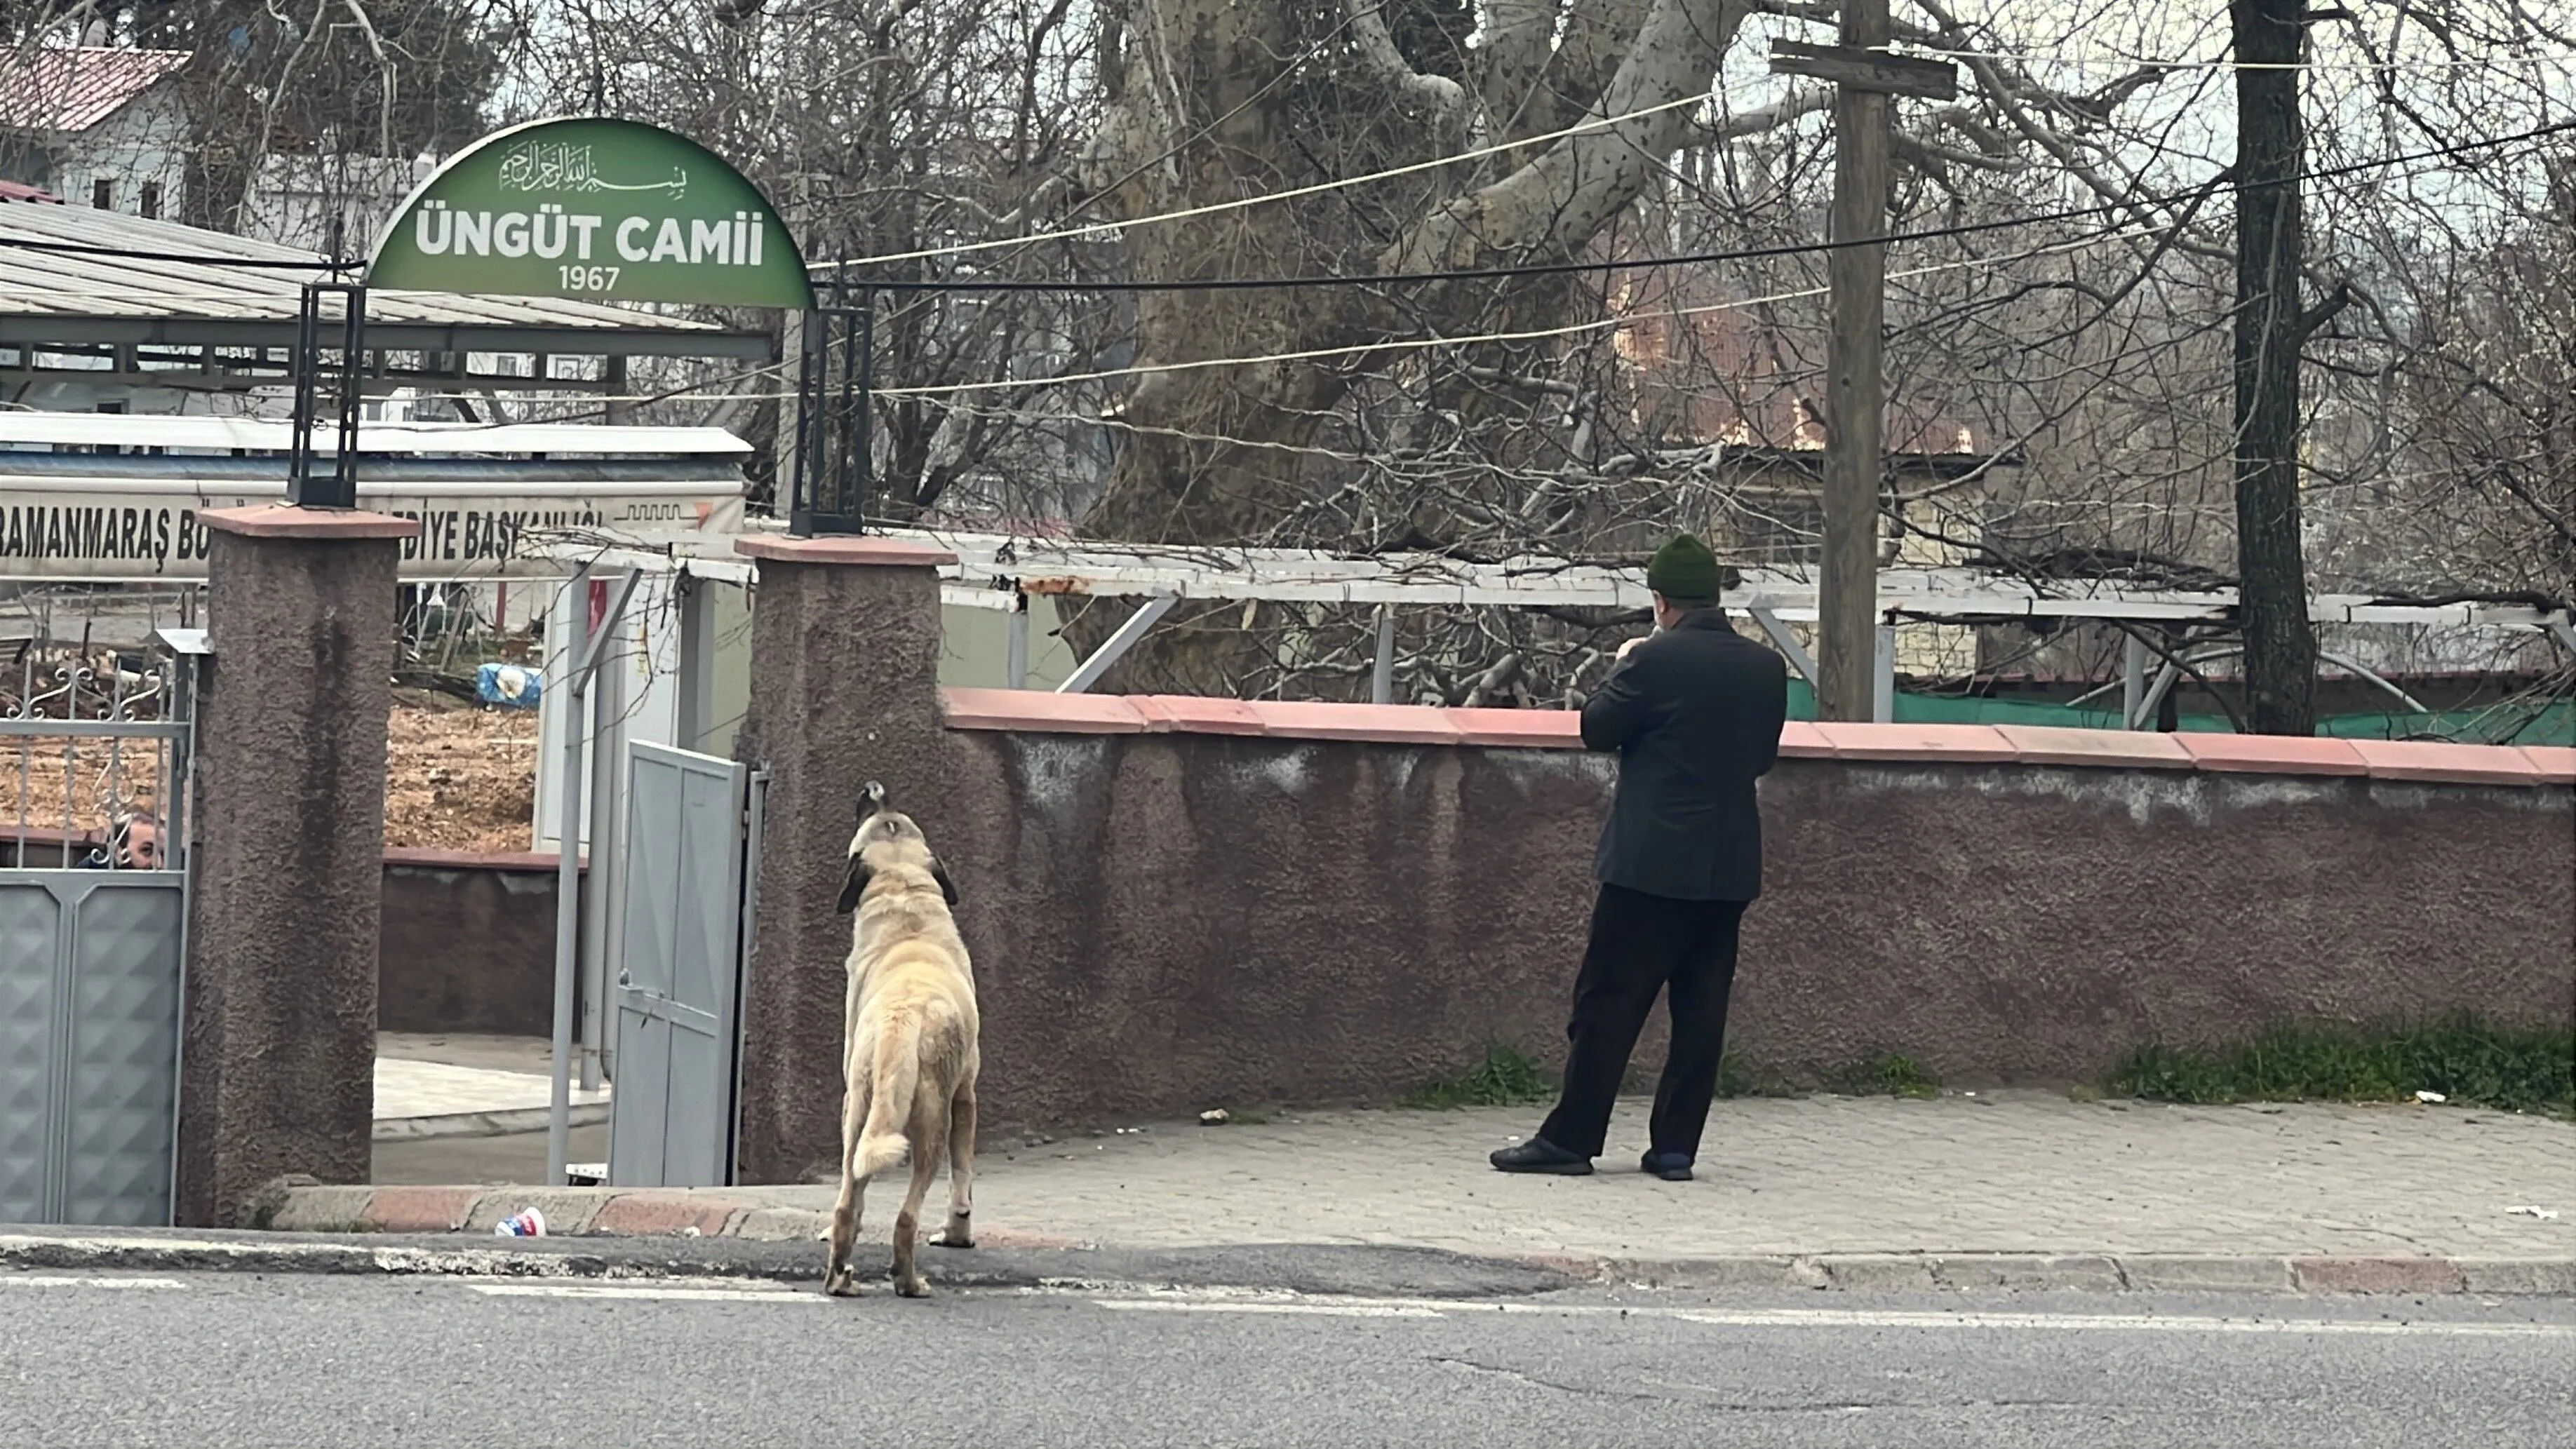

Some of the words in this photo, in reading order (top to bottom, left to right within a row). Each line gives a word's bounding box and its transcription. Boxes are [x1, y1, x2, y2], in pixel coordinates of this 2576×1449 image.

[415, 200, 601, 260] ÜNGÜT
[615, 212, 763, 266] CAMİİ
[558, 265, 620, 291] 1967
[0, 506, 170, 573] AMANMARAŞ
